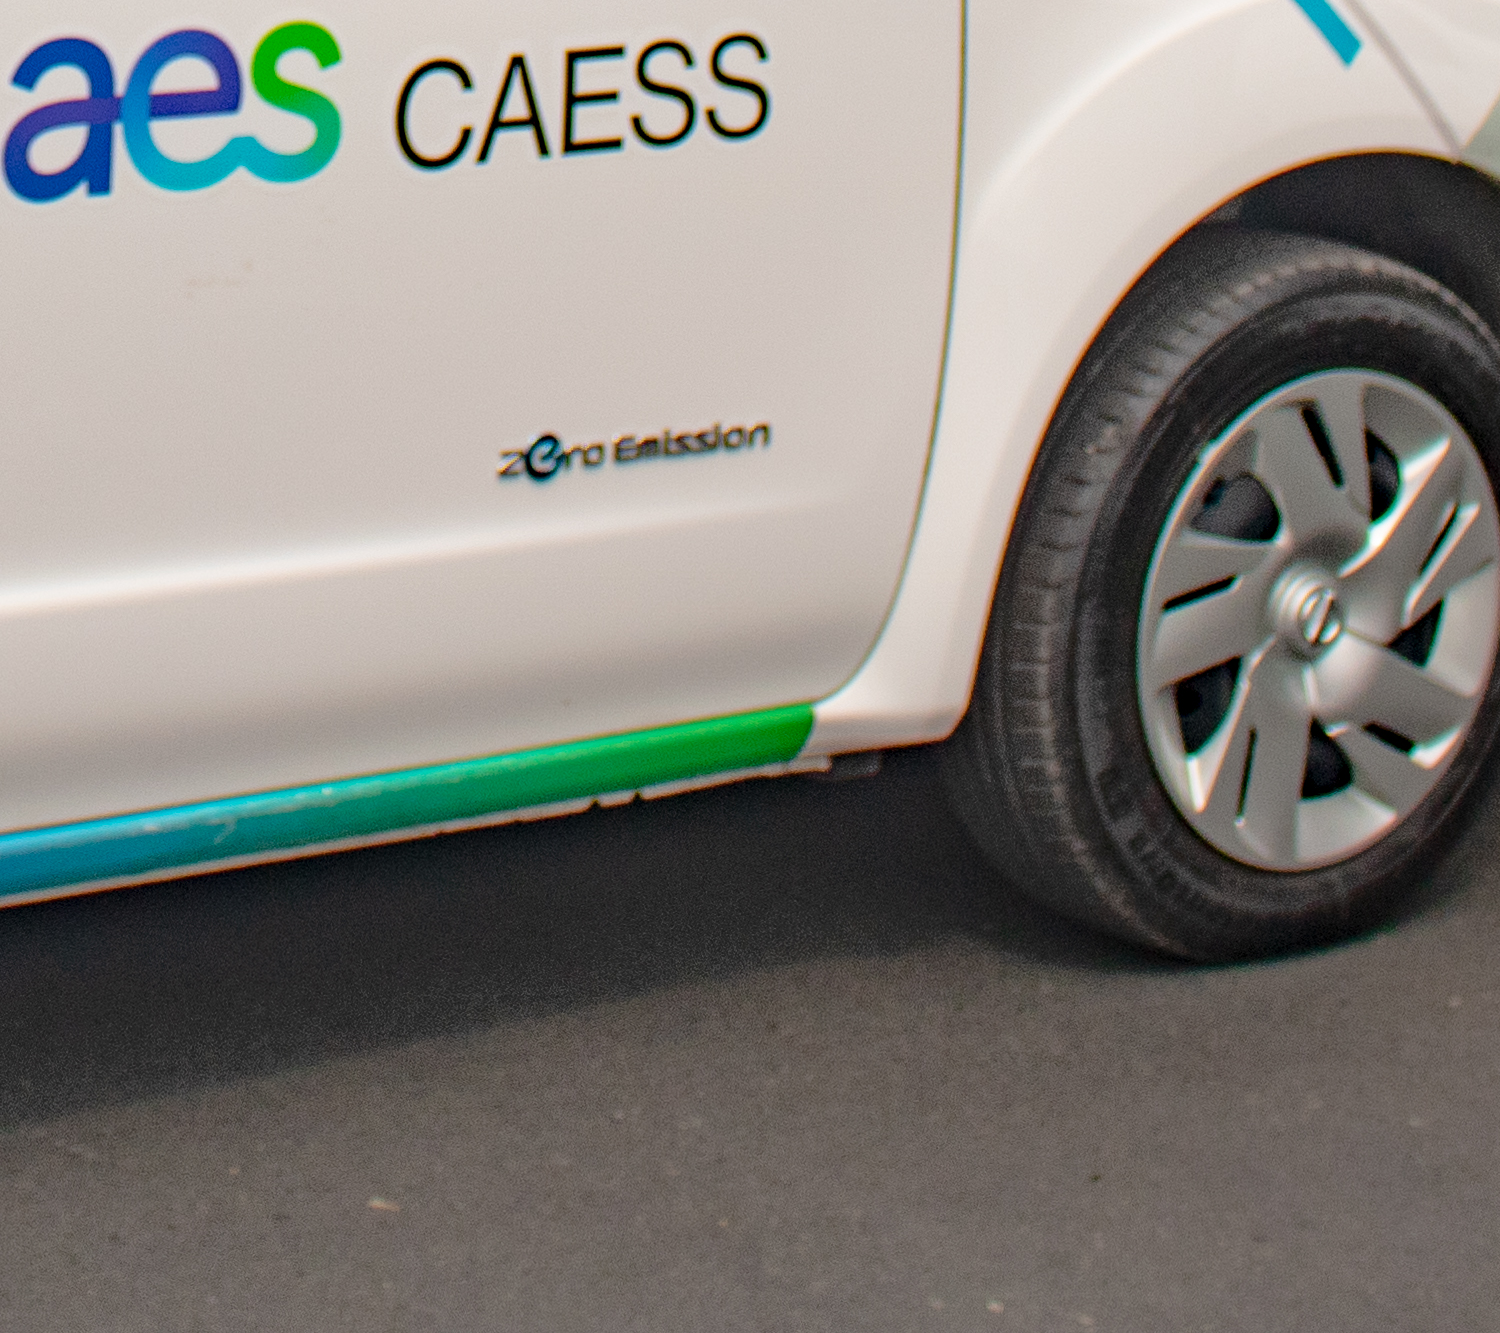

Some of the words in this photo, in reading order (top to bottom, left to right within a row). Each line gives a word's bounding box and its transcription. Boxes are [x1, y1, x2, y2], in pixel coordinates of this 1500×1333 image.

[1, 19, 344, 205] aes
[393, 31, 772, 172] CAESS
[610, 422, 771, 465] Emission
